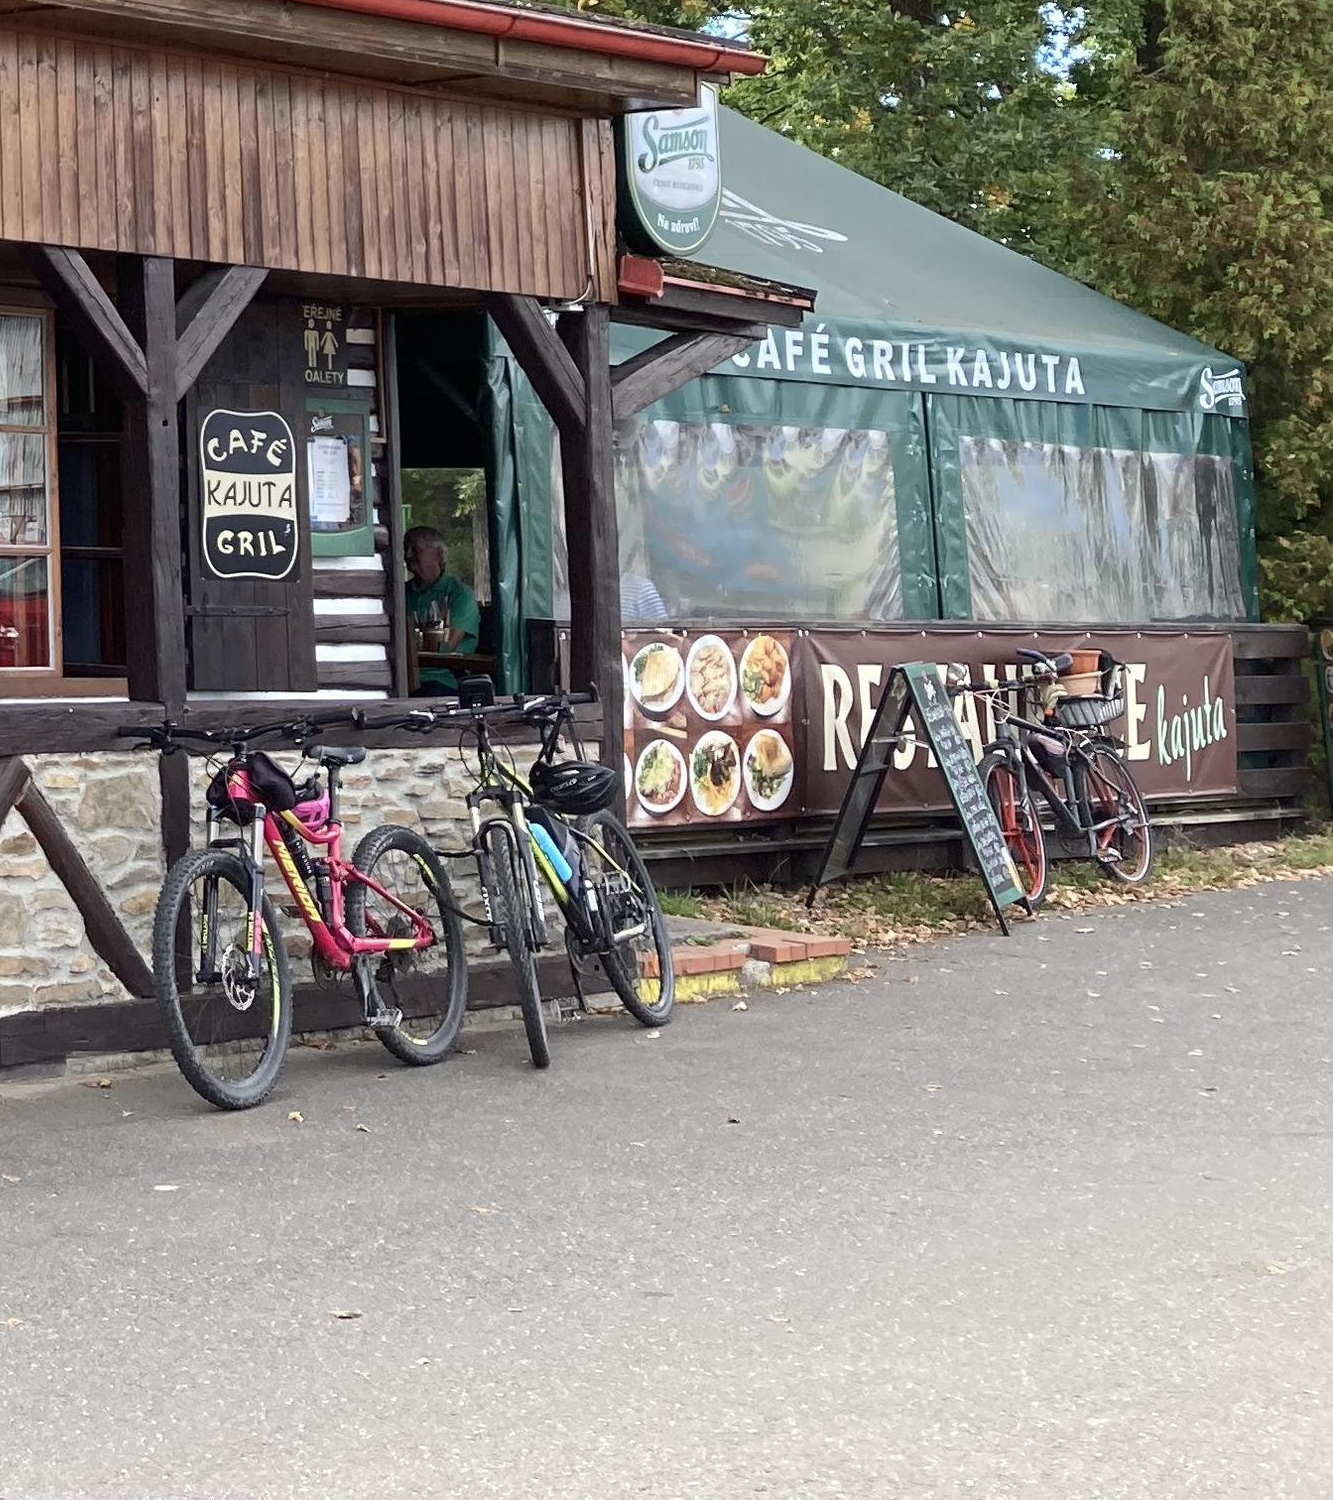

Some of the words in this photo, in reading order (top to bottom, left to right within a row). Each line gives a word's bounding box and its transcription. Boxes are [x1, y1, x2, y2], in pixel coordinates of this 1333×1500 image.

[638, 114, 713, 173] Samson
[302, 303, 342, 322] EŘEJNÉ
[305, 369, 344, 385] OALETY
[845, 336, 937, 384] GRIL
[947, 346, 1086, 396] KAJUTA
[207, 428, 288, 468] CAFÉ
[207, 479, 293, 509] KAJUTA
[217, 529, 287, 557] GRIL
[1157, 675, 1228, 782] kajuta
[272, 838, 323, 922] MERIDA
